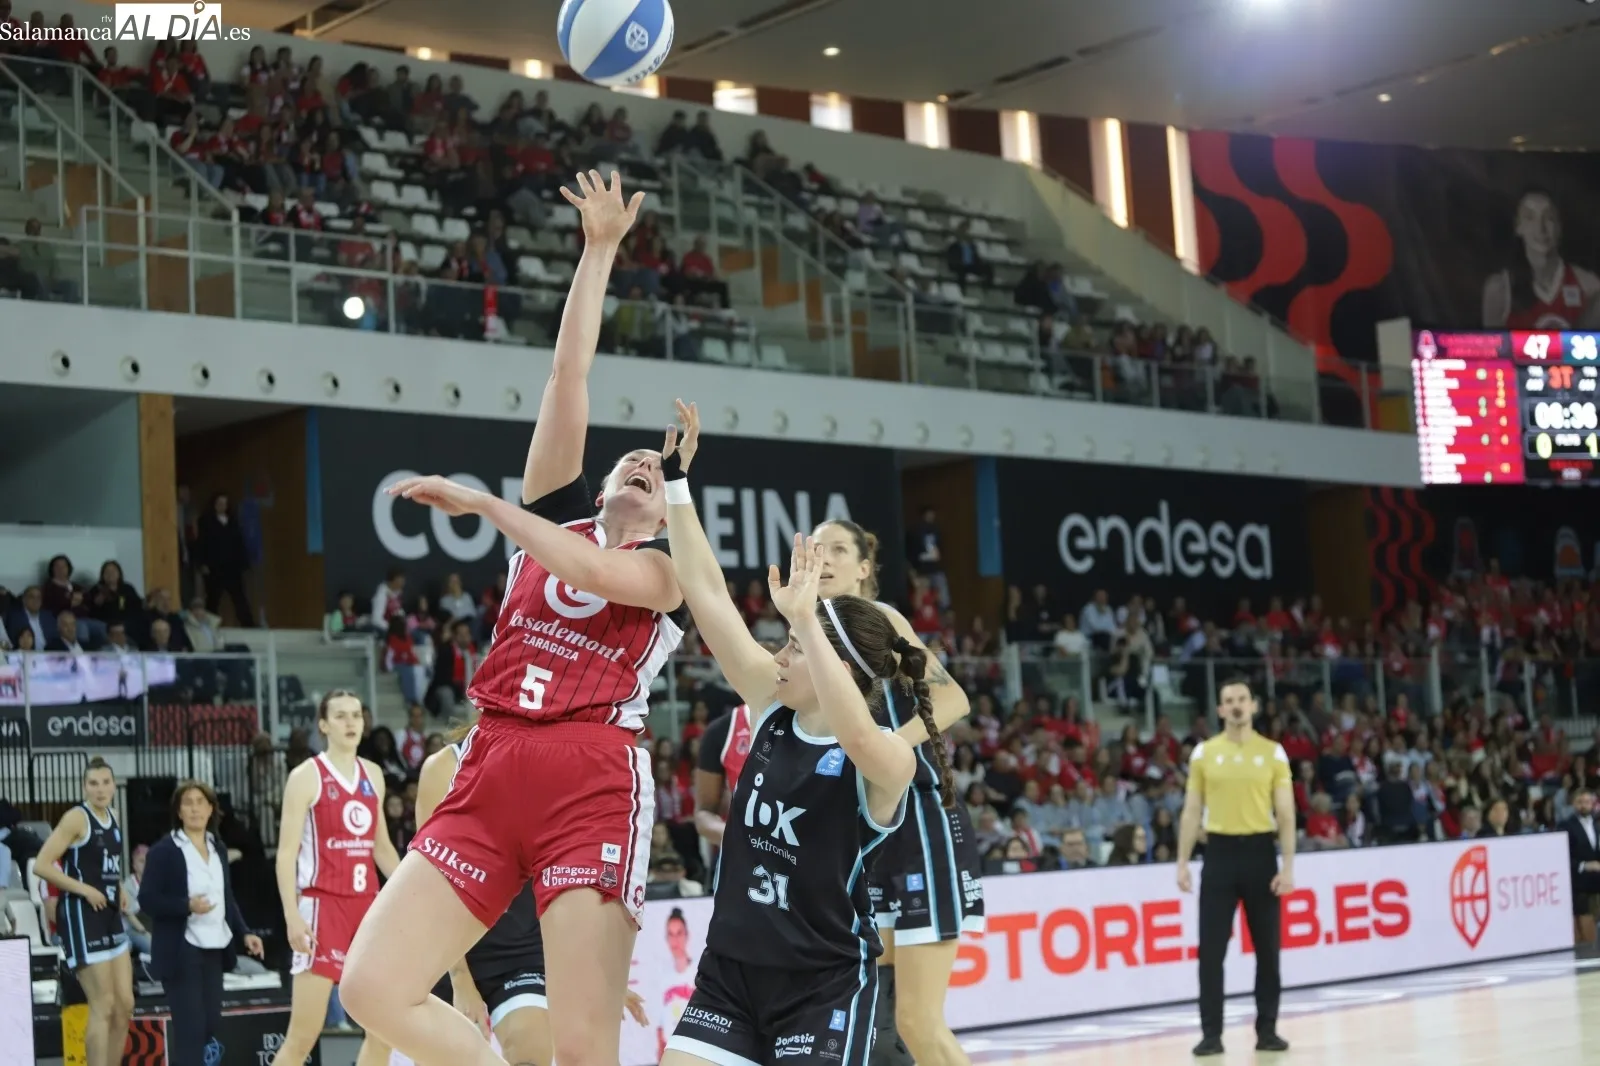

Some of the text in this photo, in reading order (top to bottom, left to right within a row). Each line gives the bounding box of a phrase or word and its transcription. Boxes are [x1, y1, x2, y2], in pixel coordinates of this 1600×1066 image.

[655, 484, 852, 569] EIN
[1058, 500, 1273, 580] endesa
[522, 633, 579, 662] ZARAGOZA
[519, 663, 554, 710] 5
[47, 711, 137, 737] endesa
[418, 837, 487, 884] Silken
[748, 834, 797, 866] ektronika
[353, 863, 367, 893] 8
[552, 865, 598, 877] Zaragoza
[747, 864, 790, 911] 31
[1496, 871, 1561, 911] STORE
[945, 878, 1411, 988] STORE.B.ES
[682, 1016, 700, 1025] ASQUE
[684, 1006, 733, 1028] EUSKADI
